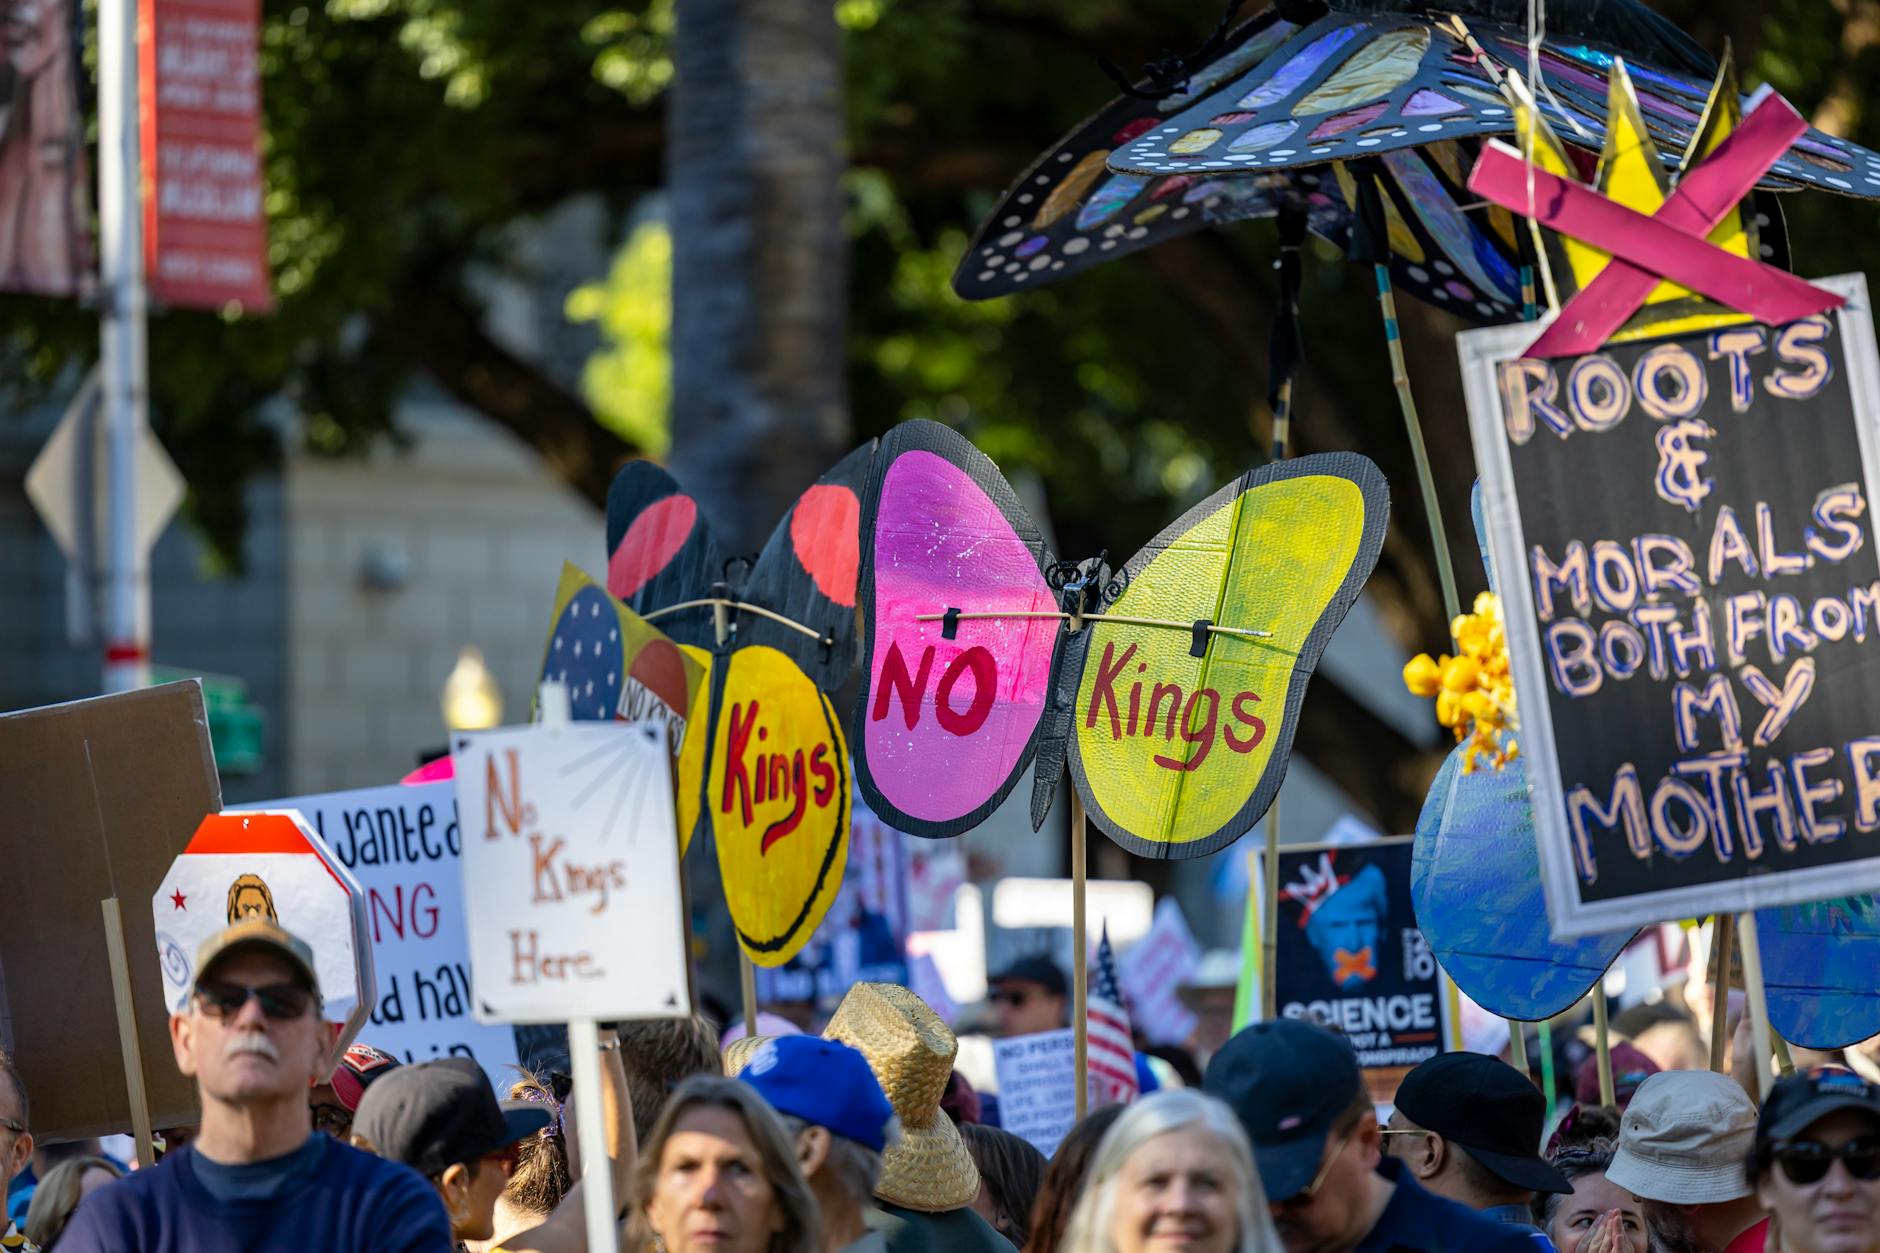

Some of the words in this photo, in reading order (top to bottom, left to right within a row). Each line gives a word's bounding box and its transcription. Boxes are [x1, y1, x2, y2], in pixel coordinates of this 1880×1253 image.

[1501, 315, 1834, 446] ROOTS
[1655, 419, 1718, 513] &
[1531, 482, 1866, 622] MORALS
[872, 640, 998, 737] NO
[1086, 640, 1266, 772] Kings
[1545, 596, 1717, 698] BOTH
[1672, 656, 1816, 753] MY
[721, 699, 836, 858] Kings
